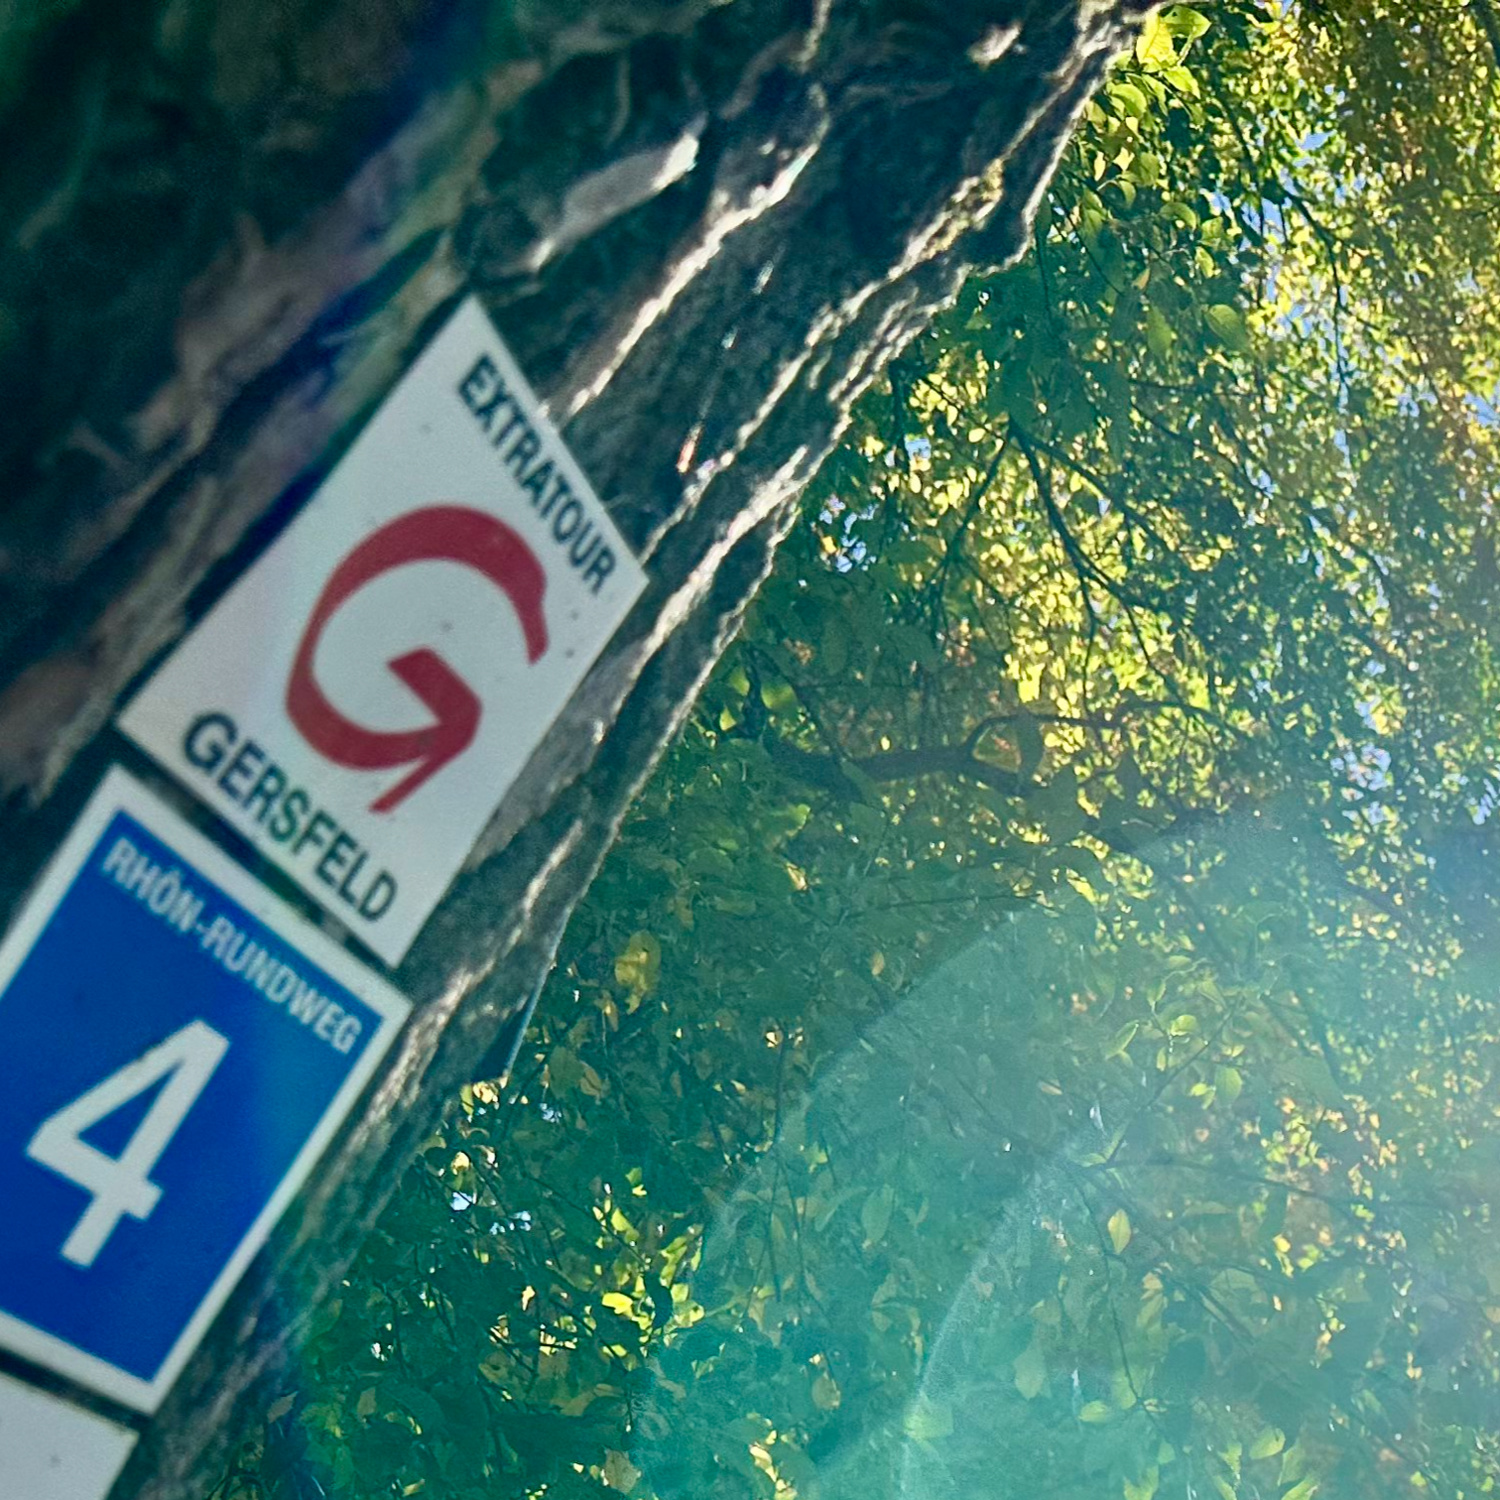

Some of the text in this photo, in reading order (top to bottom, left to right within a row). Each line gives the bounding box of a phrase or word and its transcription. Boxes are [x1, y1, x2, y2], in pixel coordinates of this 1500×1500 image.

[457, 354, 617, 597] EXTRATOUR
[182, 711, 398, 923] GERSFELD
[104, 837, 363, 1054] RHÖN-RUNDWEG
[27, 1019, 230, 1268] 4
